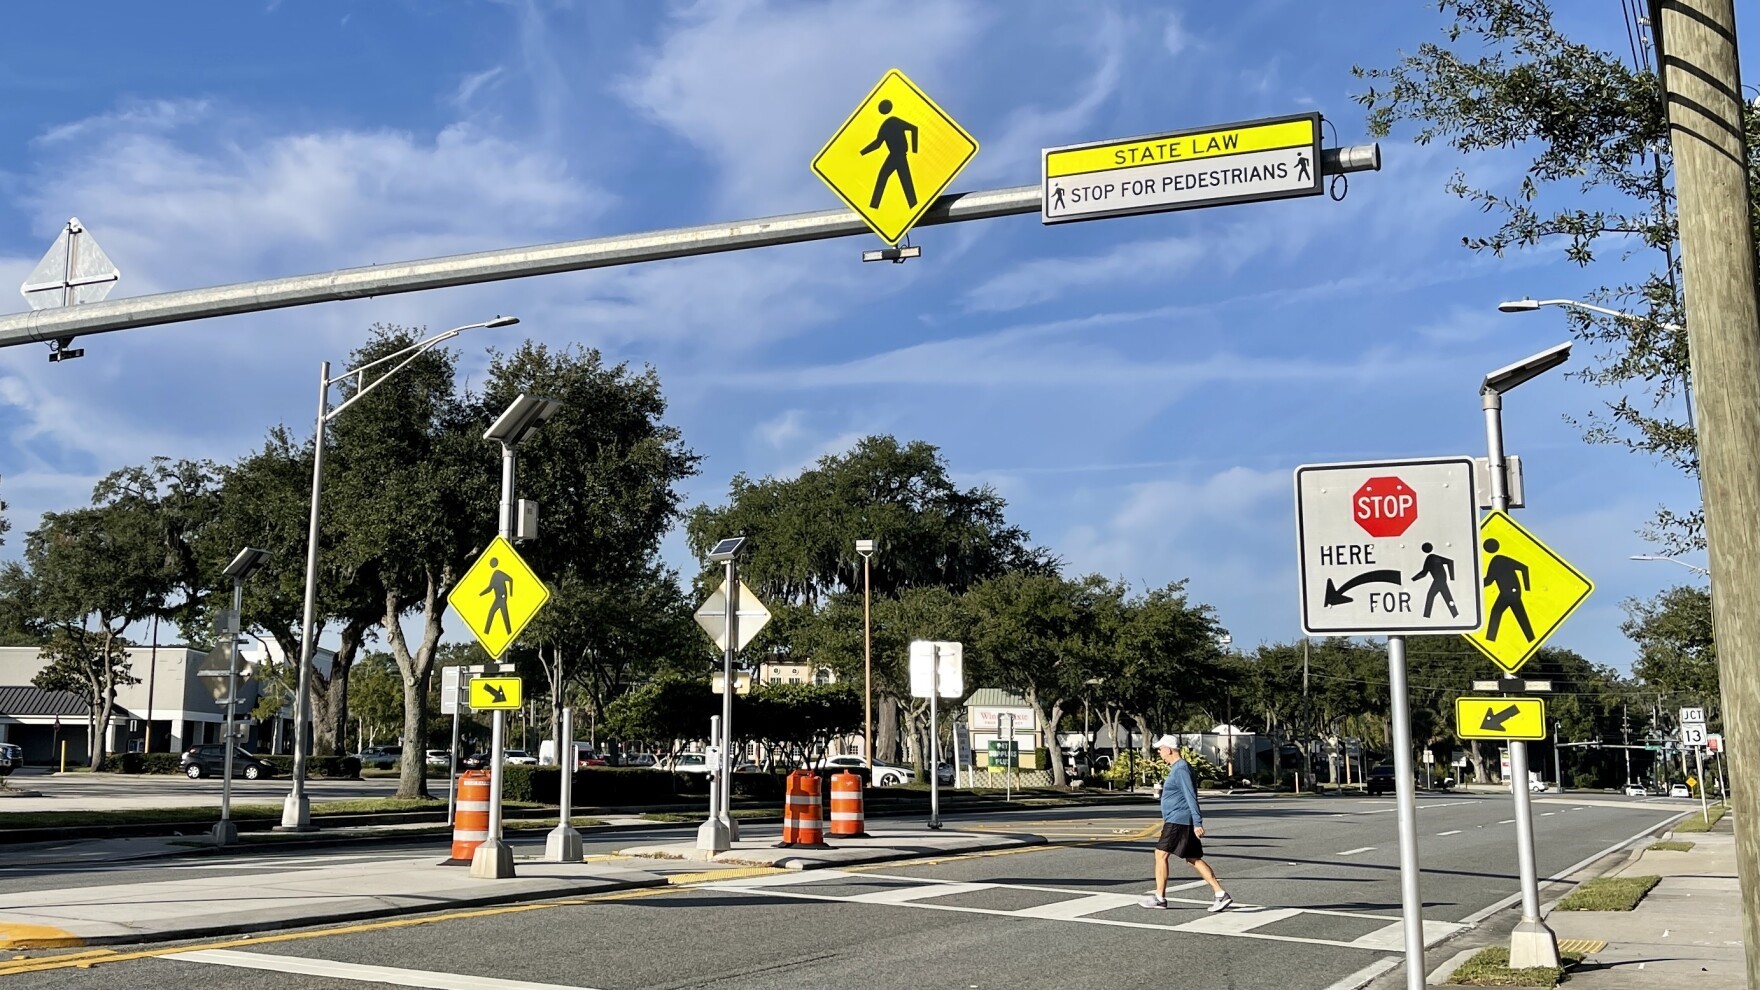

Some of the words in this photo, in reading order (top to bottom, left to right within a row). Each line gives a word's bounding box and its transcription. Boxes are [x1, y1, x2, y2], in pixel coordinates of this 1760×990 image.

[1115, 142, 1181, 165] STATE
[1193, 133, 1239, 154] LAW
[1071, 184, 1115, 203] STOP
[1121, 178, 1156, 197] FOR
[1162, 162, 1288, 193] PEDESTRIANS
[1357, 494, 1413, 519] STOP
[1320, 544, 1376, 566] HERE
[1370, 592, 1412, 613] FOR
[1684, 710, 1701, 720] JCT
[1686, 729, 1701, 742] 13
[988, 750, 1017, 758] SUPPLES
